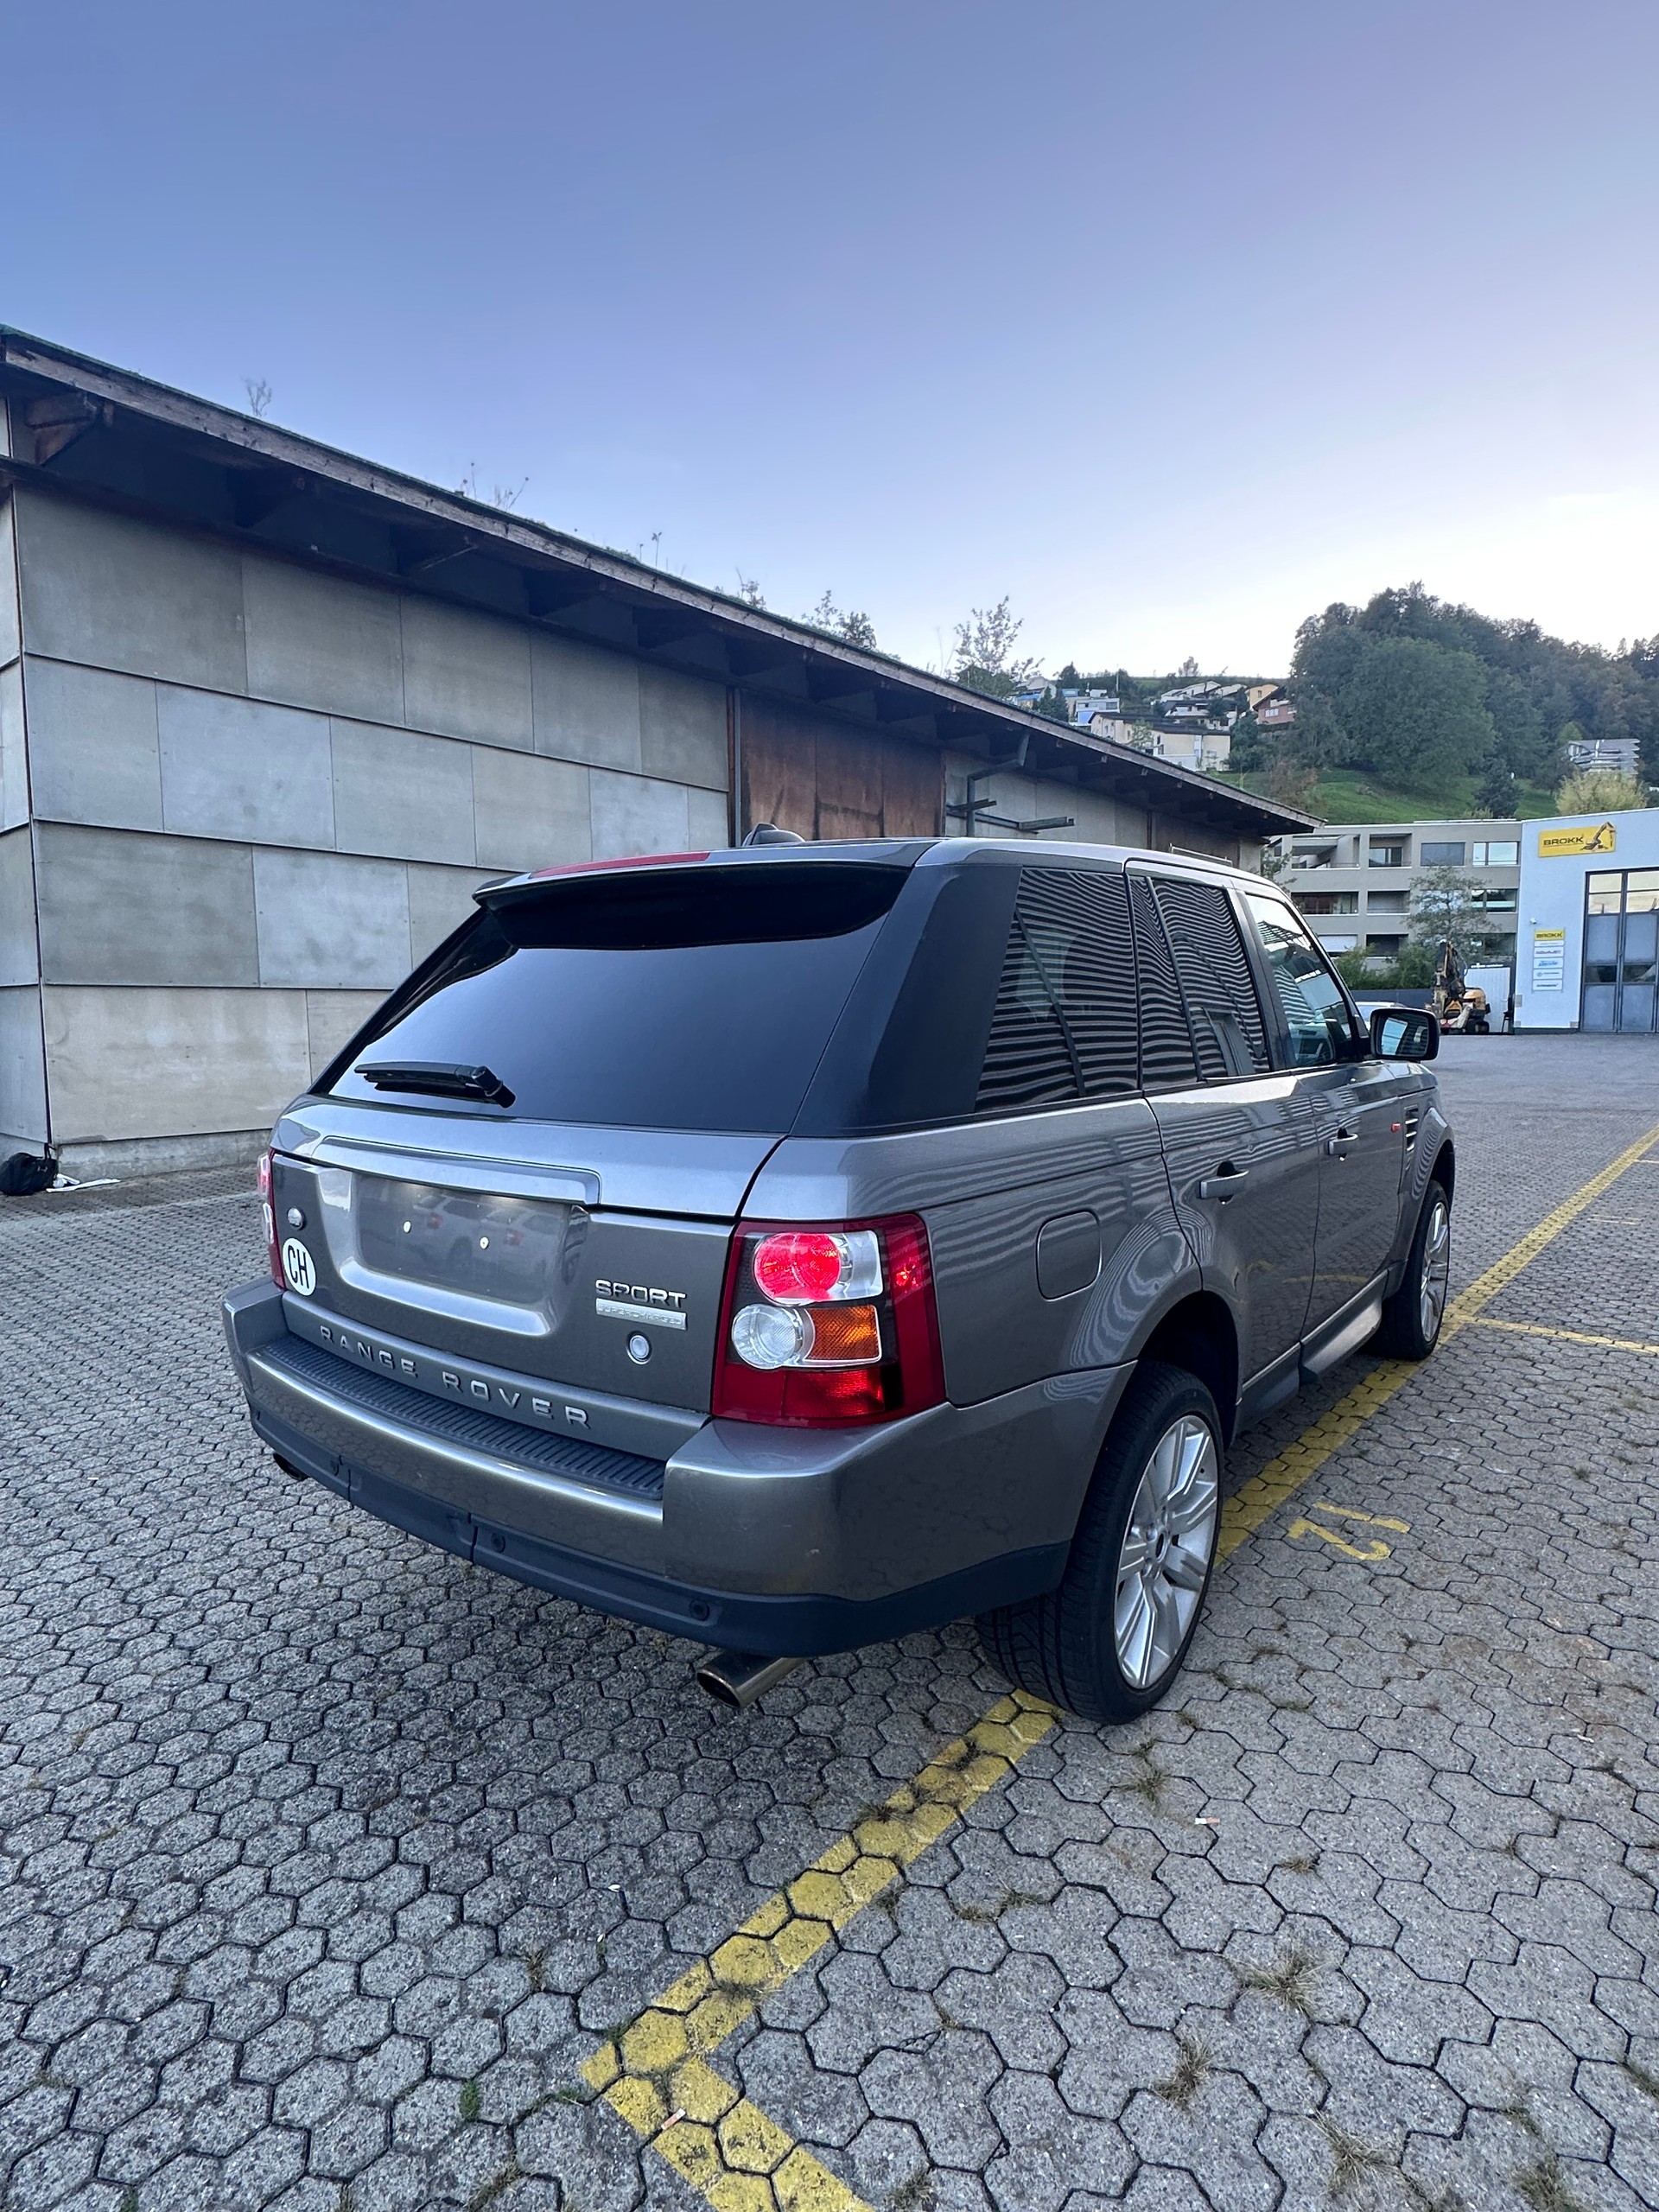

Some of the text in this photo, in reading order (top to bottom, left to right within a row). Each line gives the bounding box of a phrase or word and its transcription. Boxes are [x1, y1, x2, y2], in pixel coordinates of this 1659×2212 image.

[1543, 836, 1584, 845] BROKK
[288, 1244, 310, 1289] CH
[595, 1279, 687, 1308] SPORT
[320, 1325, 592, 1429] RANGE ROVER
